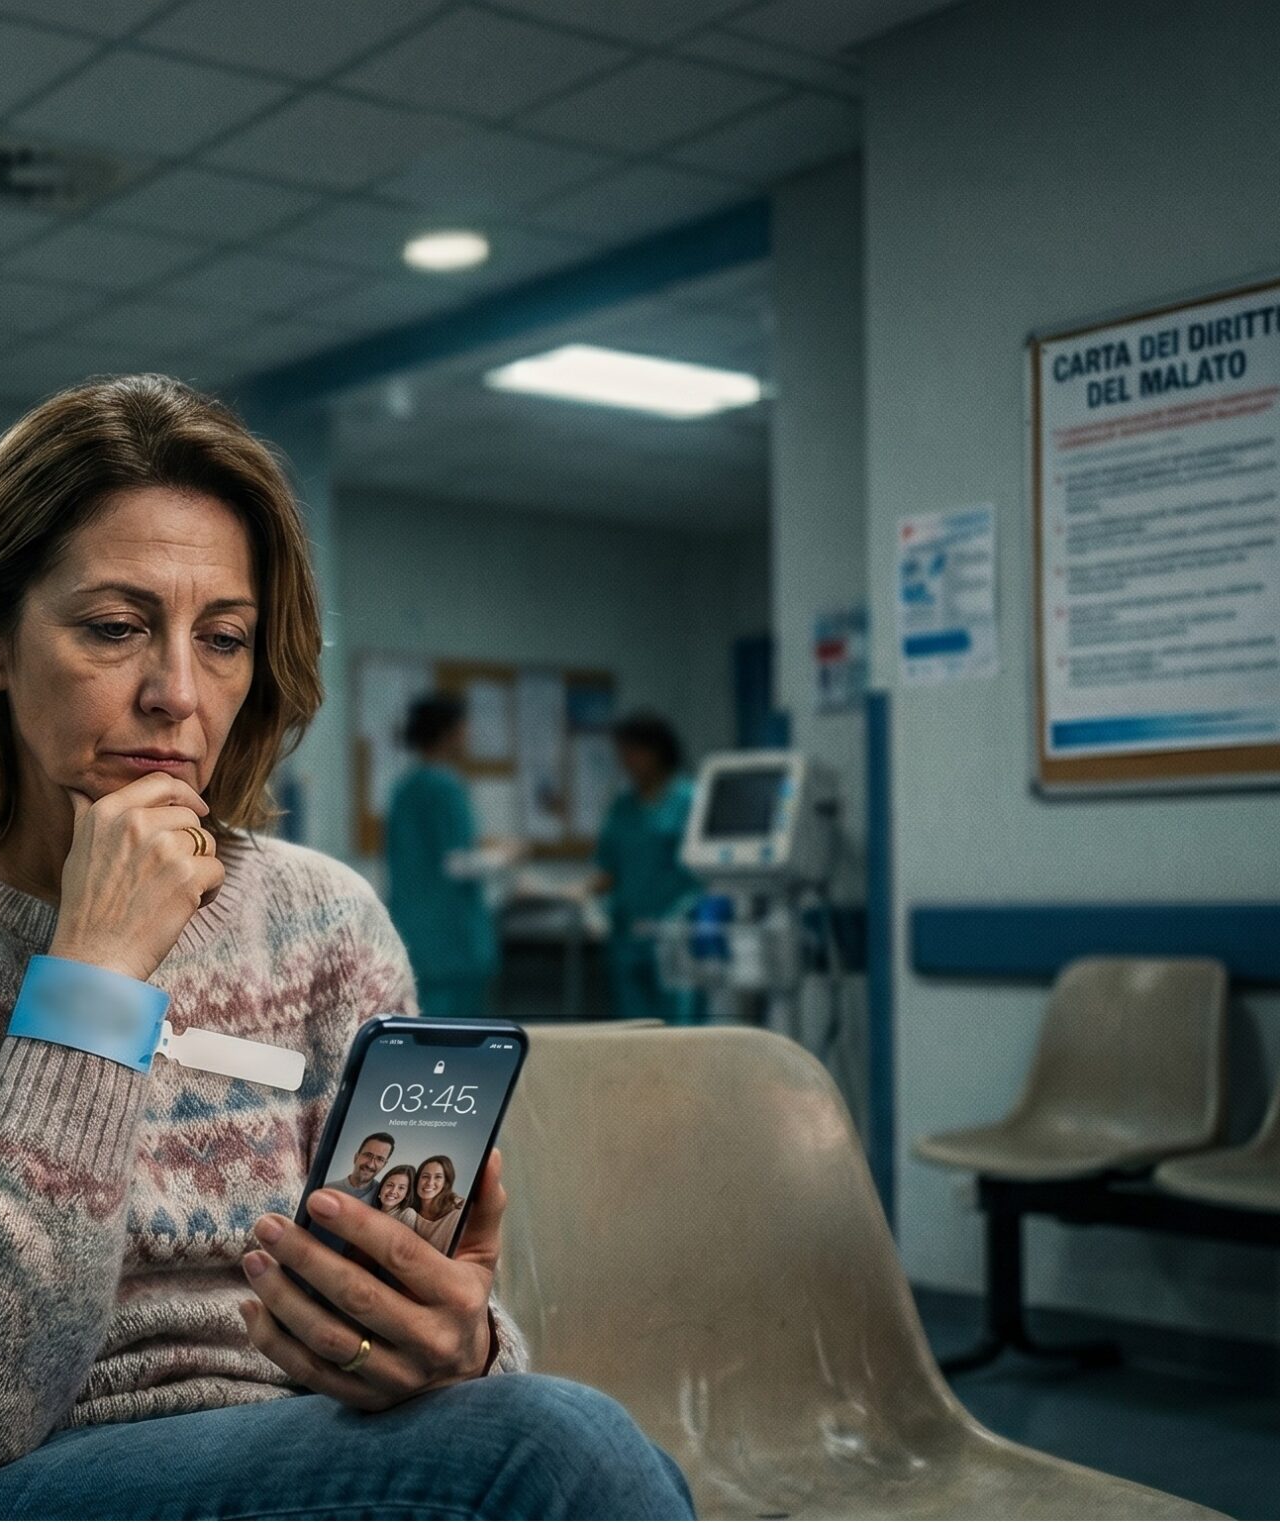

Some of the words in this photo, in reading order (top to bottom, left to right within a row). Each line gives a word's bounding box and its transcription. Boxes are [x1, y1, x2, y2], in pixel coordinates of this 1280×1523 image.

[1053, 341, 1132, 383] CARTA
[1139, 328, 1180, 363] DEI
[1087, 377, 1130, 409] DEL
[1140, 350, 1246, 397] MALATO
